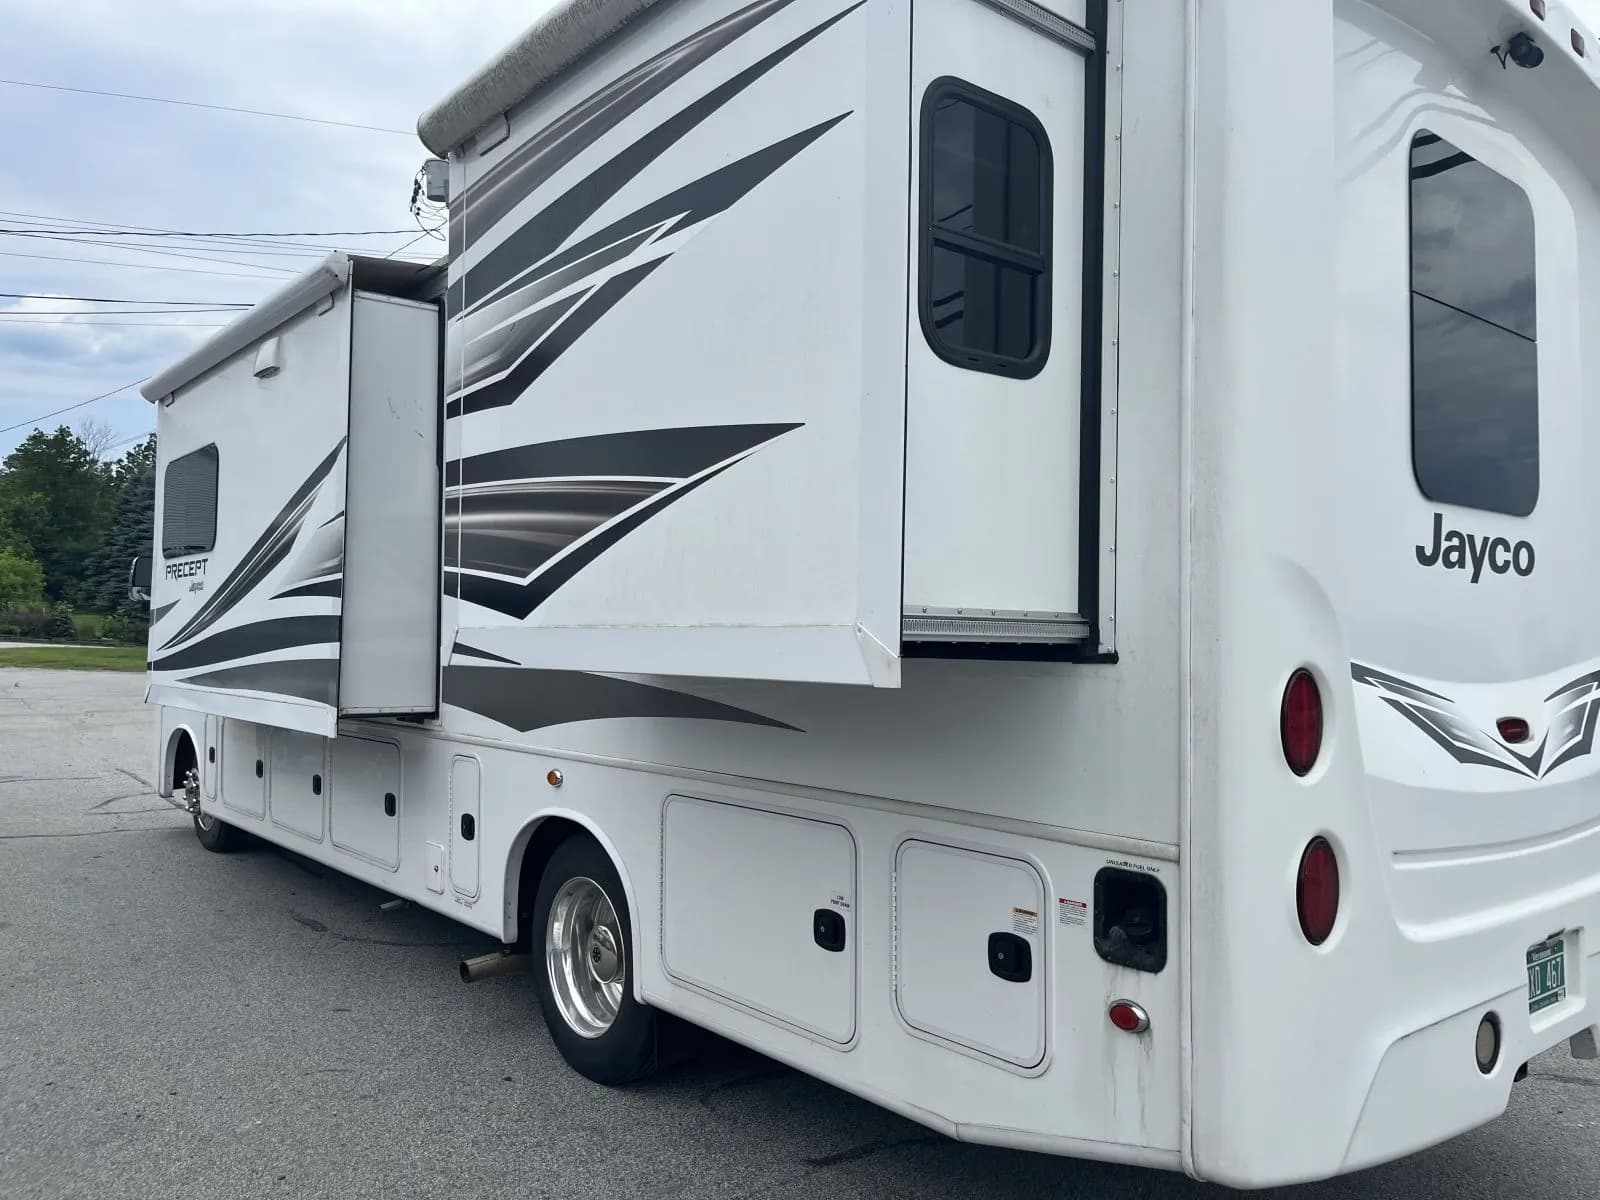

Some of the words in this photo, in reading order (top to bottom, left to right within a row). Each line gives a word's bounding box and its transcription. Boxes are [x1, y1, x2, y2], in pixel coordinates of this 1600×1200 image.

[1415, 512, 1535, 584] Jayco
[166, 558, 208, 581] PRECEPT
[1546, 957, 1561, 989] 467
